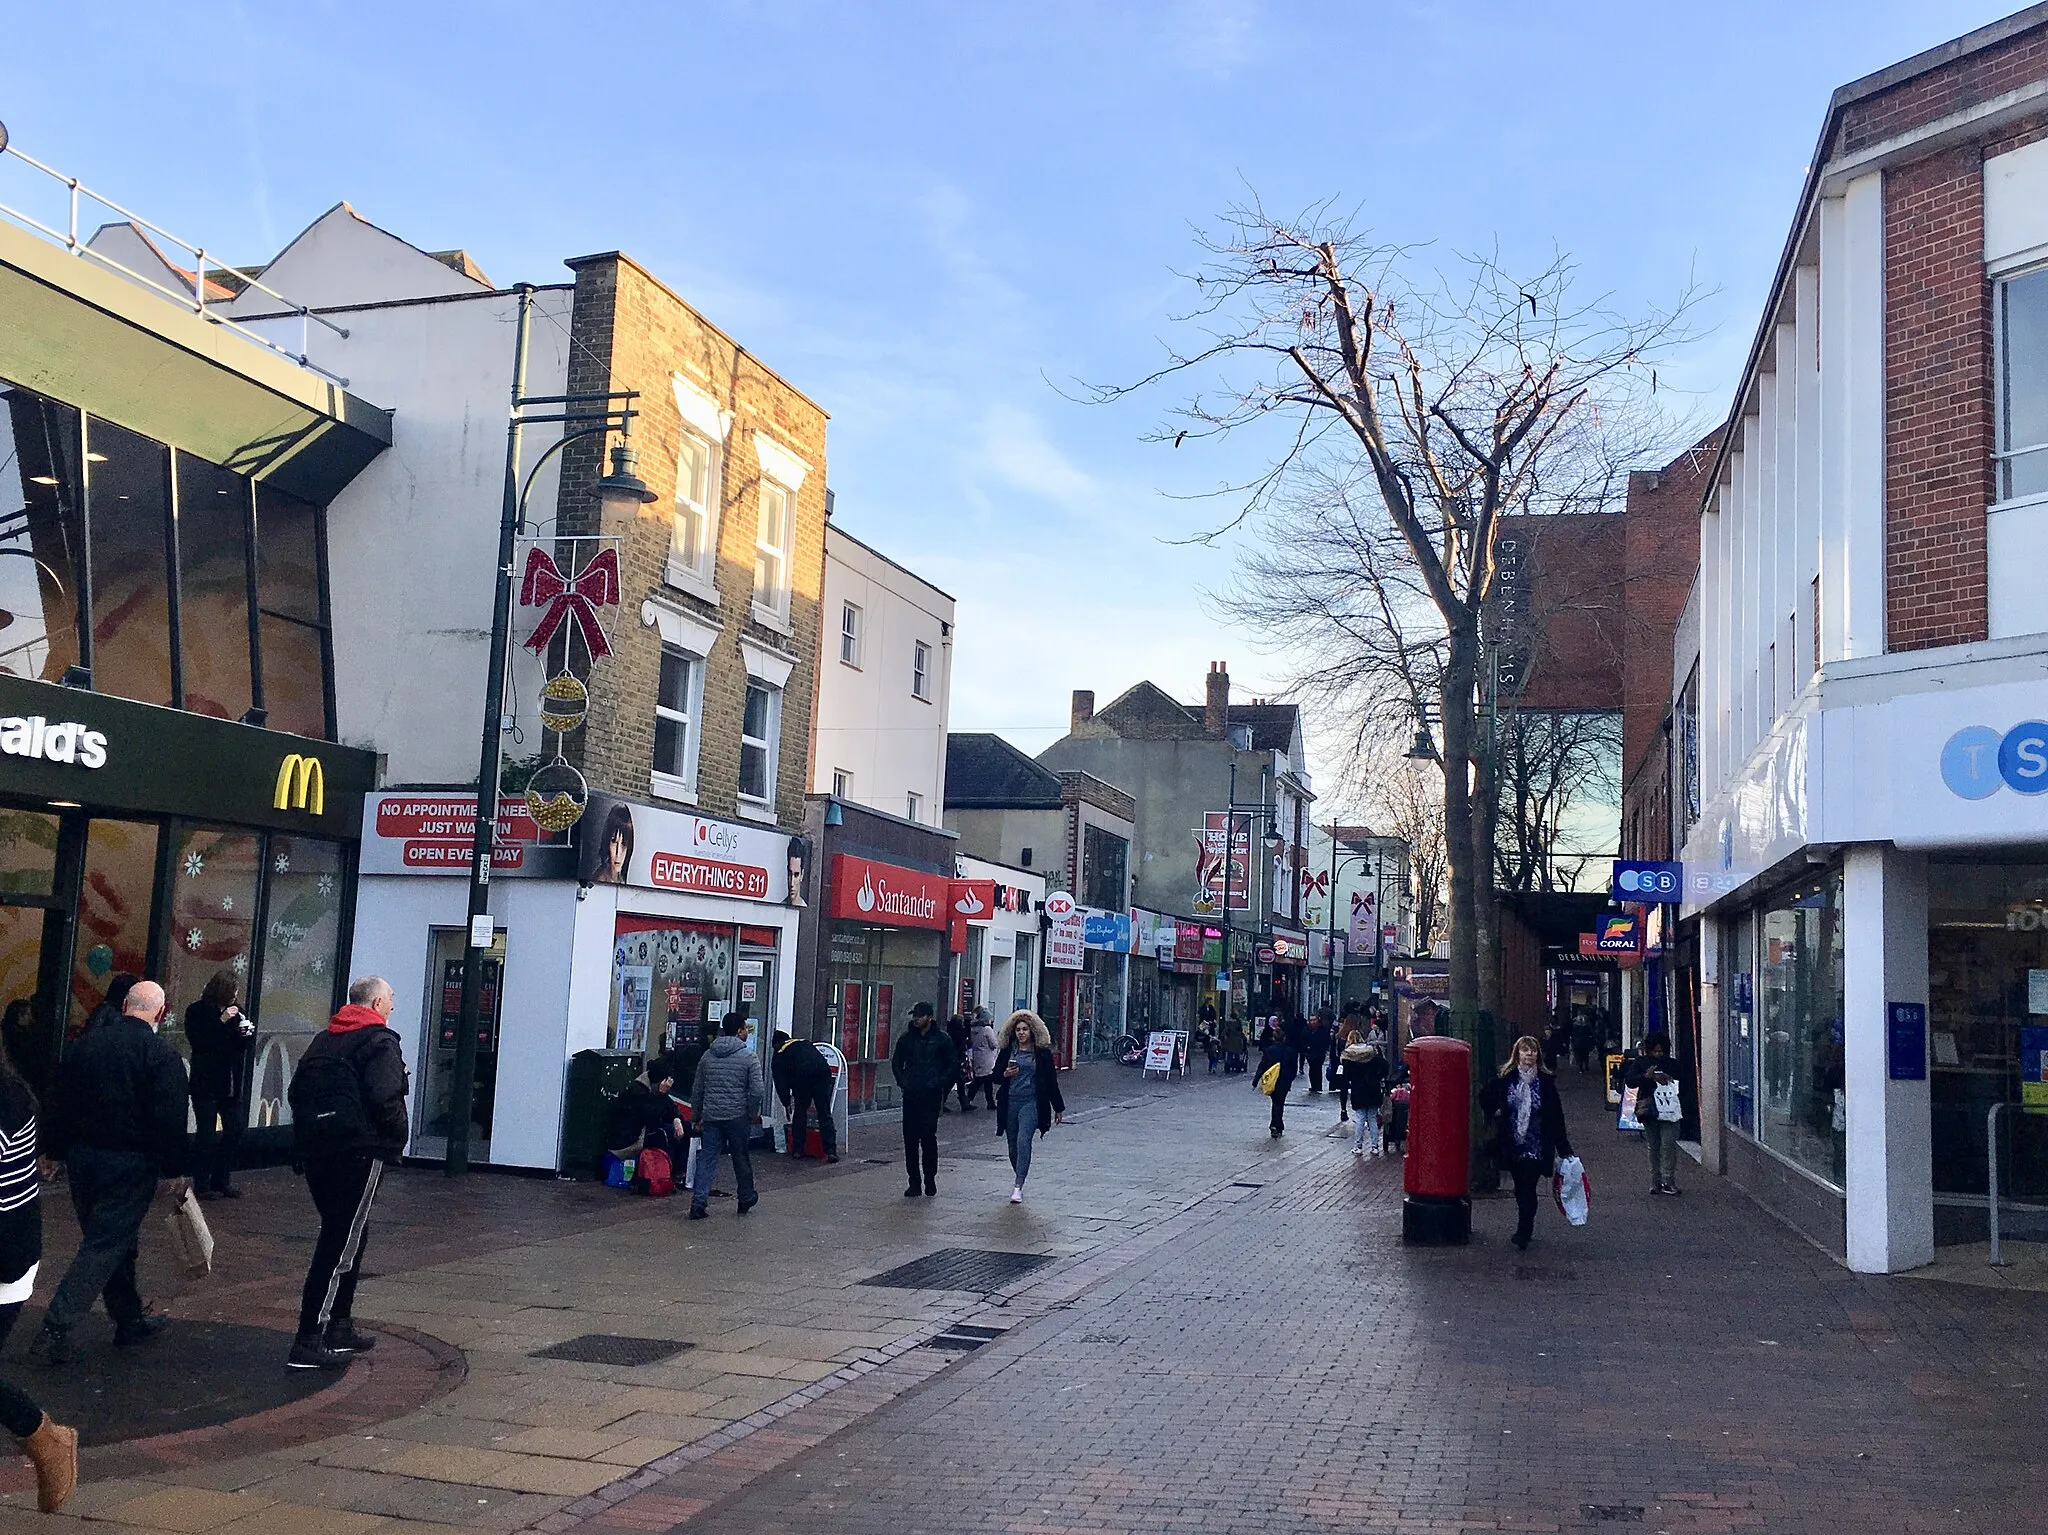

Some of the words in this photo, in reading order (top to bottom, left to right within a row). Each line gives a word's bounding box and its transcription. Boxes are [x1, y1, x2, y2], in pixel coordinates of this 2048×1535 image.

[381, 804, 400, 816] NO
[403, 804, 477, 817] APPOINTME
[501, 805, 530, 817] NEE
[418, 822, 453, 834] JUST
[455, 822, 476, 834] WA
[497, 823, 511, 834] IN
[709, 824, 738, 853] Celly's
[409, 847, 445, 860] OPEN
[447, 848, 474, 860] EVE
[494, 849, 521, 861] DAY
[655, 859, 745, 890] EVERYTHING'S
[747, 875, 766, 893] £11
[877, 879, 936, 919] Santander
[1097, 924, 1115, 937] Ryder
[1600, 940, 1636, 948] CORAL
[1558, 953, 1617, 962] DEBENHAMS
